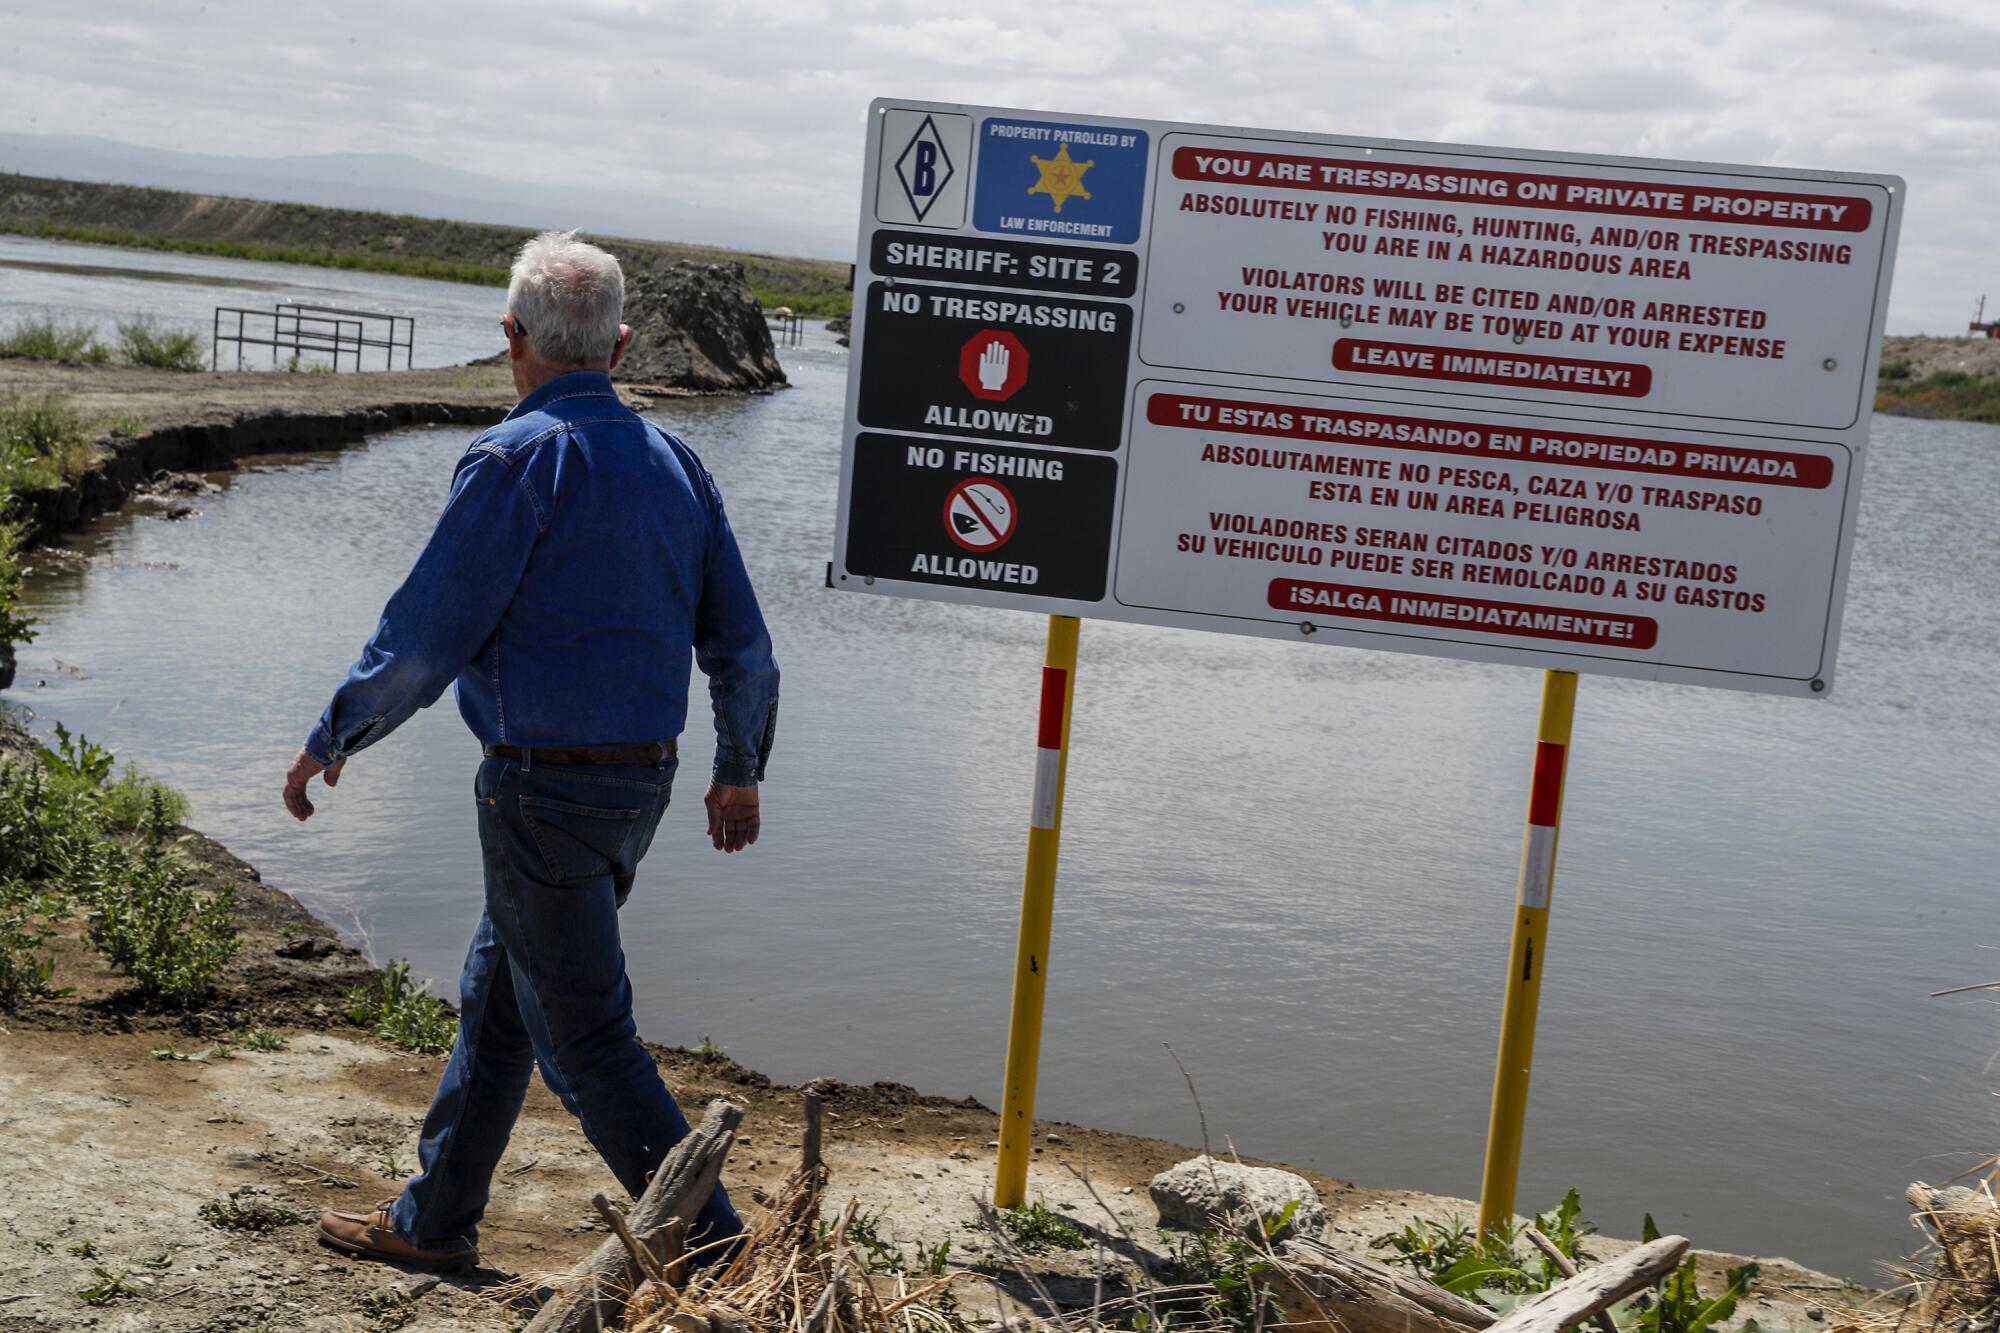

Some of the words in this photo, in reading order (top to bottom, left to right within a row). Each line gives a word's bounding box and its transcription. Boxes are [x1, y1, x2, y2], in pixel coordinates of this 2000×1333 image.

[991, 125, 1050, 140] PROPERTY
[1054, 130, 1117, 145] PATROLLED
[1121, 136, 1136, 147] BY
[914, 140, 936, 196] B
[1196, 156, 1250, 176] YOU
[1258, 162, 1311, 181] ARE
[1320, 167, 1507, 196] TRESPASSING
[1518, 182, 1557, 200] ON
[1567, 186, 1684, 210] PRIVATE
[1693, 196, 1847, 221] PROPERTY
[1001, 217, 1024, 229] LAW
[1028, 219, 1112, 236] ENFORCEMENT
[1180, 193, 1319, 223] ABSOLUTELY
[1327, 207, 1357, 224] NO
[1364, 208, 1464, 238] FISHING,
[1472, 216, 1582, 246] HUNTING,
[1590, 225, 1679, 252] AND/OR
[1691, 234, 1850, 264] TRESPASSING
[887, 243, 1017, 274] SHERIFF:
[1029, 256, 1092, 281] SITE
[1103, 263, 1120, 283] 2
[1324, 233, 1366, 255] YOU
[1375, 237, 1418, 256] ARE
[1427, 241, 1450, 259] IN
[1457, 244, 1472, 261] A
[1481, 246, 1621, 274] HAZARDOUS
[1630, 257, 1690, 279] AREA
[884, 292, 919, 313] NO
[930, 296, 1115, 332] TRESPASSING
[1243, 268, 1364, 296] VIOLATORS
[1373, 278, 1426, 301] WILL
[1436, 284, 1464, 305] BE
[1472, 288, 1539, 311] CITED
[1548, 295, 1635, 319] AND/OR
[1644, 303, 1766, 329] ARRESTED
[1220, 293, 1276, 314] YOUR
[1286, 299, 1378, 323] VEHICLE
[1389, 308, 1436, 328] MAY
[1445, 313, 1471, 333] BE
[1484, 315, 1562, 340] TOWED
[1572, 324, 1599, 341] AT
[1609, 327, 1670, 349] YOUR
[1680, 332, 1783, 358] EXPENSE
[1353, 347, 1433, 369] LEAVE
[1443, 356, 1630, 387] IMMEDIATELY!
[925, 406, 1052, 435] ALLOWED
[1180, 404, 1210, 421] TU
[1219, 408, 1292, 429] ESTAS
[1302, 416, 1480, 447] TRASPASANDO
[1489, 434, 1521, 451] EN
[1531, 438, 1675, 465] PROPIEDAD
[1685, 453, 1796, 477] PRIVADA
[908, 447, 943, 468] NO
[954, 452, 1063, 480] FISHING
[1201, 444, 1391, 480] ABSOLUTAMENTE
[1400, 464, 1429, 484] NO
[1438, 466, 1519, 495] PESCA,
[1528, 475, 1586, 497] CAZA
[1597, 481, 1633, 503] Y/O
[1641, 486, 1763, 516] TRASPASO
[1309, 481, 1361, 502] ESTA
[1371, 487, 1400, 507] EN
[1408, 492, 1437, 511] UN
[1446, 496, 1504, 517] AREA
[1512, 501, 1640, 530] PELIGROSA
[912, 554, 1038, 584] ALLOWED
[1179, 534, 1205, 552] SU
[1215, 538, 1323, 565] VEHICULO
[1331, 550, 1403, 574] PUEDE
[1411, 558, 1455, 581] SER
[1462, 564, 1605, 596] REMOLCADO
[1613, 580, 1627, 597] A
[1637, 582, 1666, 601] SU
[1675, 585, 1765, 612] GASTOS
[1211, 513, 1347, 544] VIOLADORES
[1355, 528, 1428, 551] SERAN
[1436, 536, 1532, 563] CITADOS
[1543, 548, 1578, 567] Y/O
[1586, 552, 1737, 584] ARRESTADOS
[1291, 587, 1381, 611] ¡SALGA
[1392, 598, 1633, 638] INMEDIATAMENTE!
